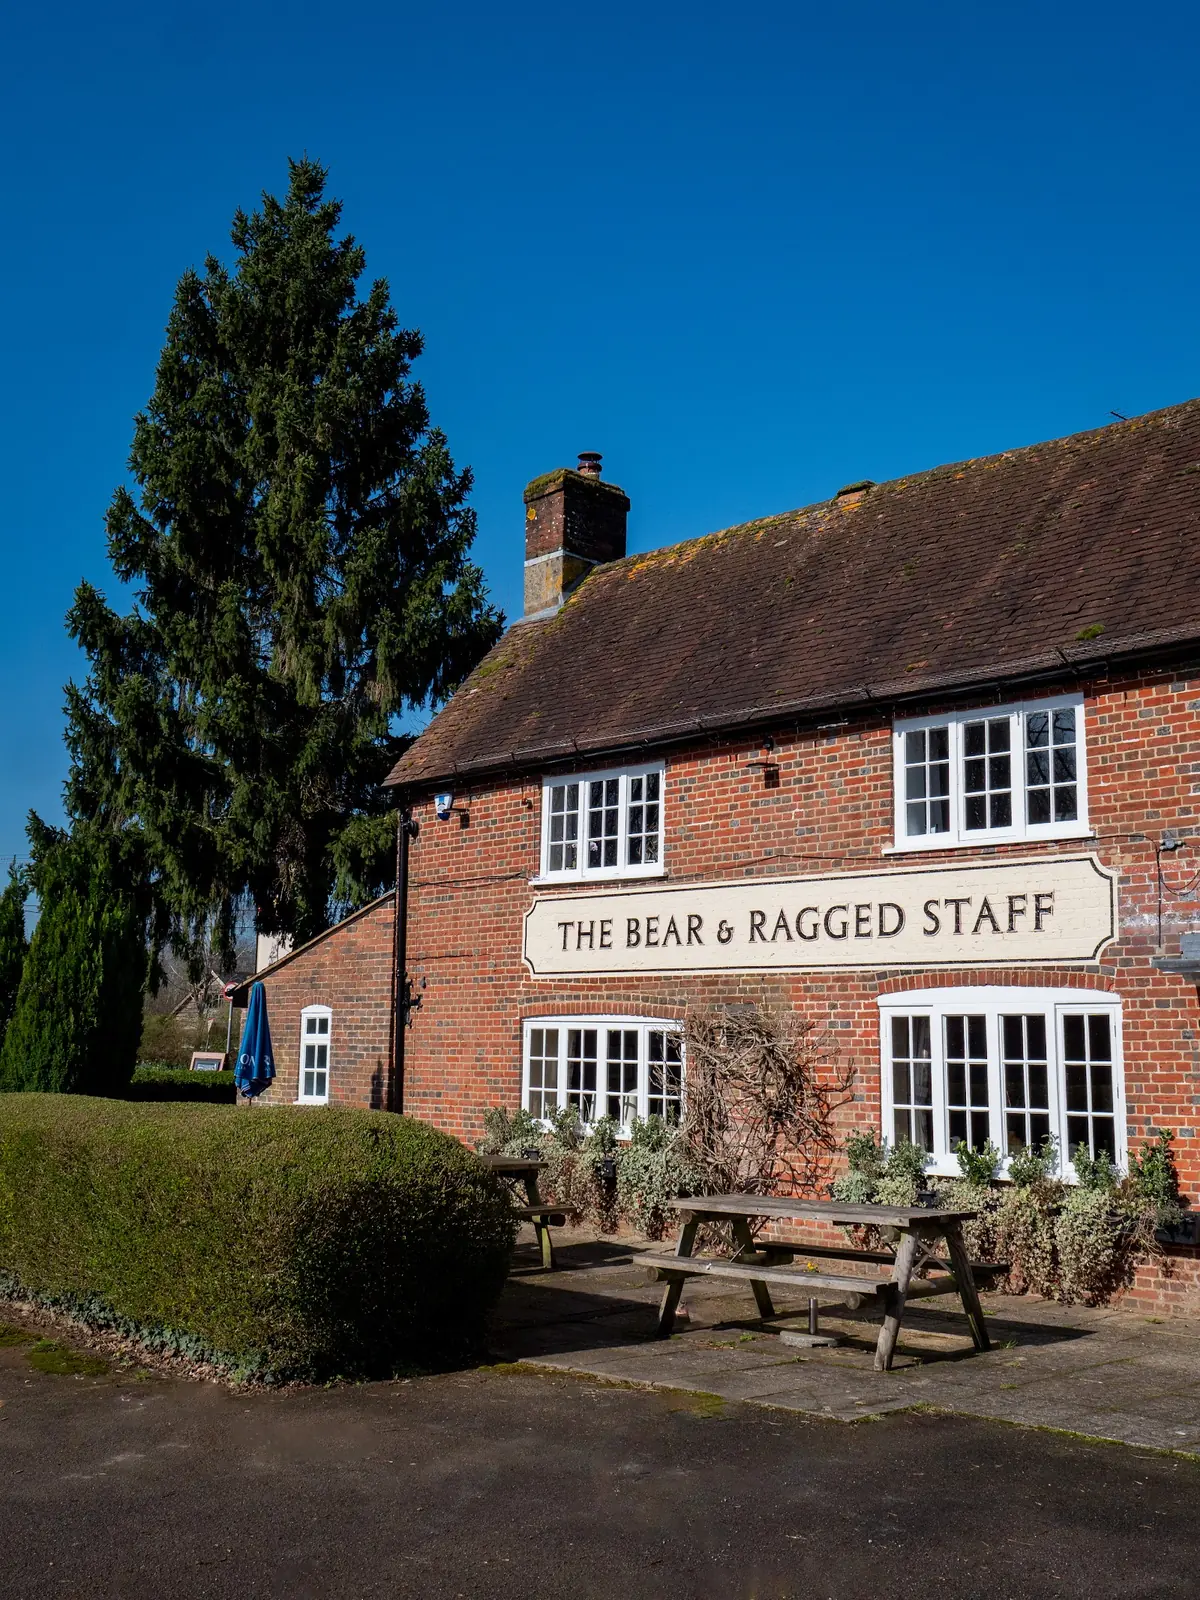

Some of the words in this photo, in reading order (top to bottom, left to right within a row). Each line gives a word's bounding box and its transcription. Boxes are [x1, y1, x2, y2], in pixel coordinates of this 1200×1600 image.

[557, 918, 613, 951] THE
[626, 914, 704, 949] BEAR
[716, 919, 734, 945] &
[748, 902, 906, 943] RAGGED
[922, 890, 1055, 936] STAFF
